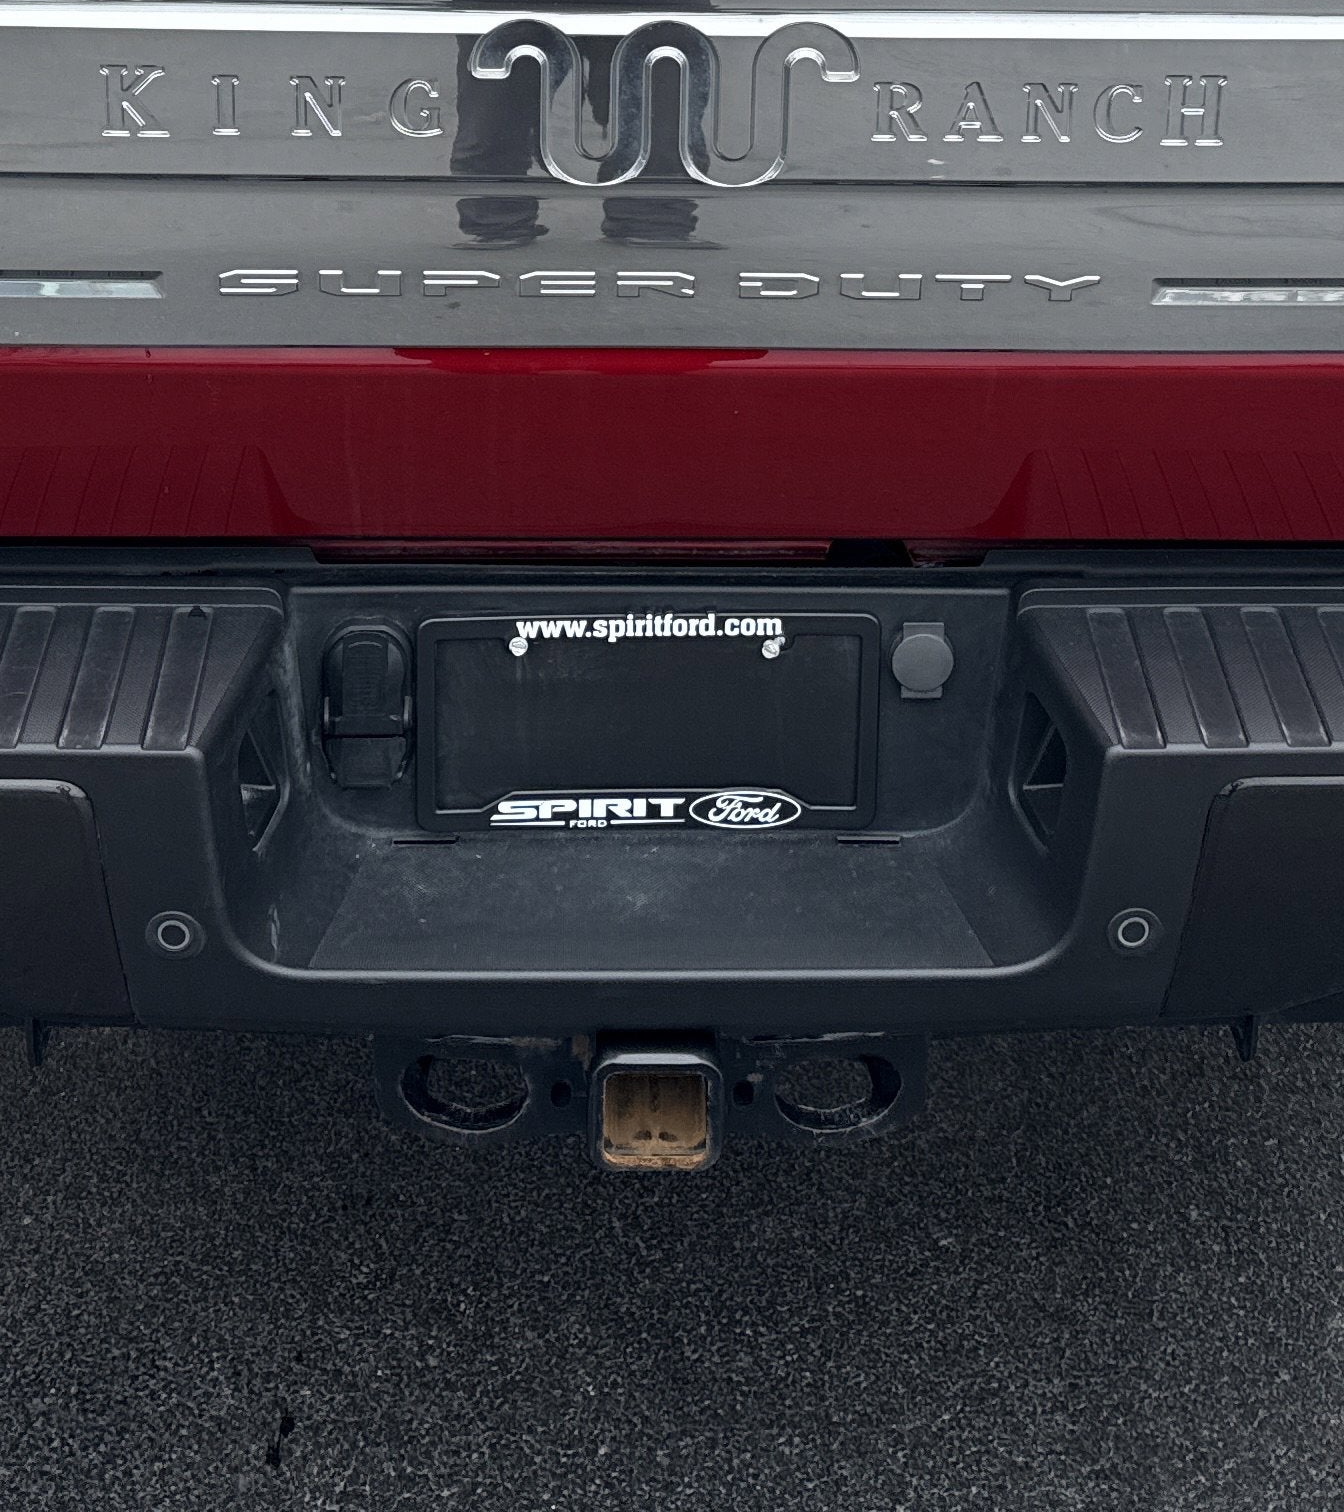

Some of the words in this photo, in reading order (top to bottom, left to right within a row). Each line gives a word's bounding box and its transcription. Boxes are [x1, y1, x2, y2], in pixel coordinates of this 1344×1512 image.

[99, 63, 444, 139] KING
[870, 74, 1229, 147] RANCH
[219, 269, 696, 298] SUPER
[738, 272, 1101, 302] DUTY
[515, 613, 783, 643] www.spiritford.com
[490, 797, 686, 821] SPIRIT
[707, 794, 781, 824] Ford
[569, 819, 608, 829] FORD
